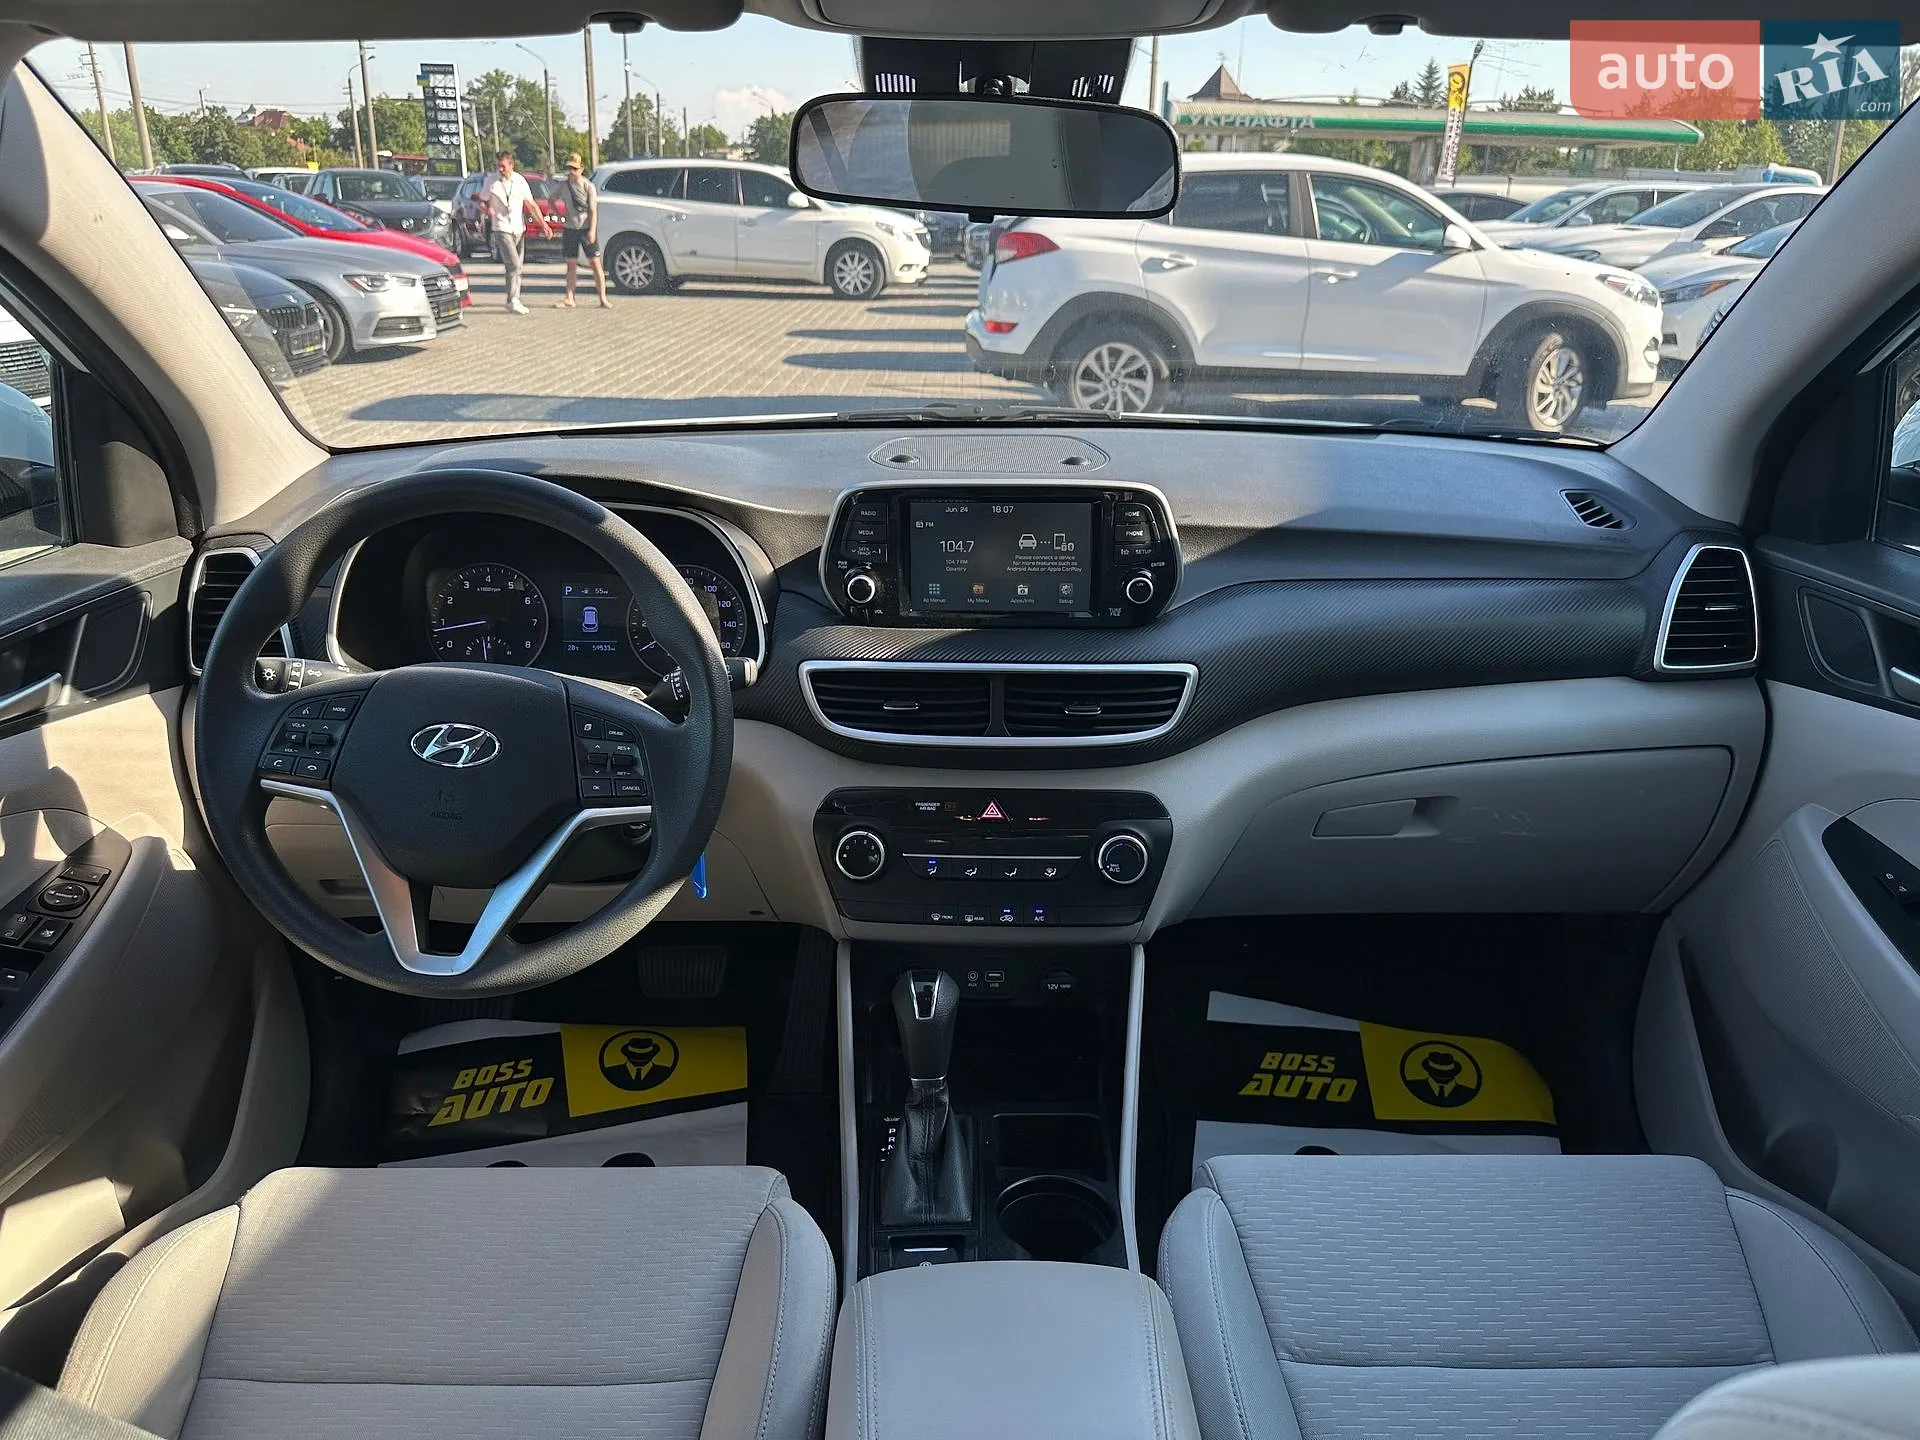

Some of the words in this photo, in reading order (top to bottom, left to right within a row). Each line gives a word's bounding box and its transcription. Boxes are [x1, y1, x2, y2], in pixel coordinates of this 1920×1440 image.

[939, 540, 975, 553] 104.7
[485, 575, 491, 583] 4
[463, 581, 470, 589] 3
[565, 586, 573, 595] P
[447, 596, 453, 605] 2
[524, 596, 531, 605] 6
[718, 600, 731, 608] 120
[532, 619, 538, 627] 7
[446, 640, 453, 648] 0
[525, 640, 531, 648] 8
[1259, 1051, 1337, 1074] BOSS
[452, 1057, 534, 1091] BOSS
[1238, 1073, 1358, 1103] AUTO
[427, 1077, 555, 1128] AUTO
